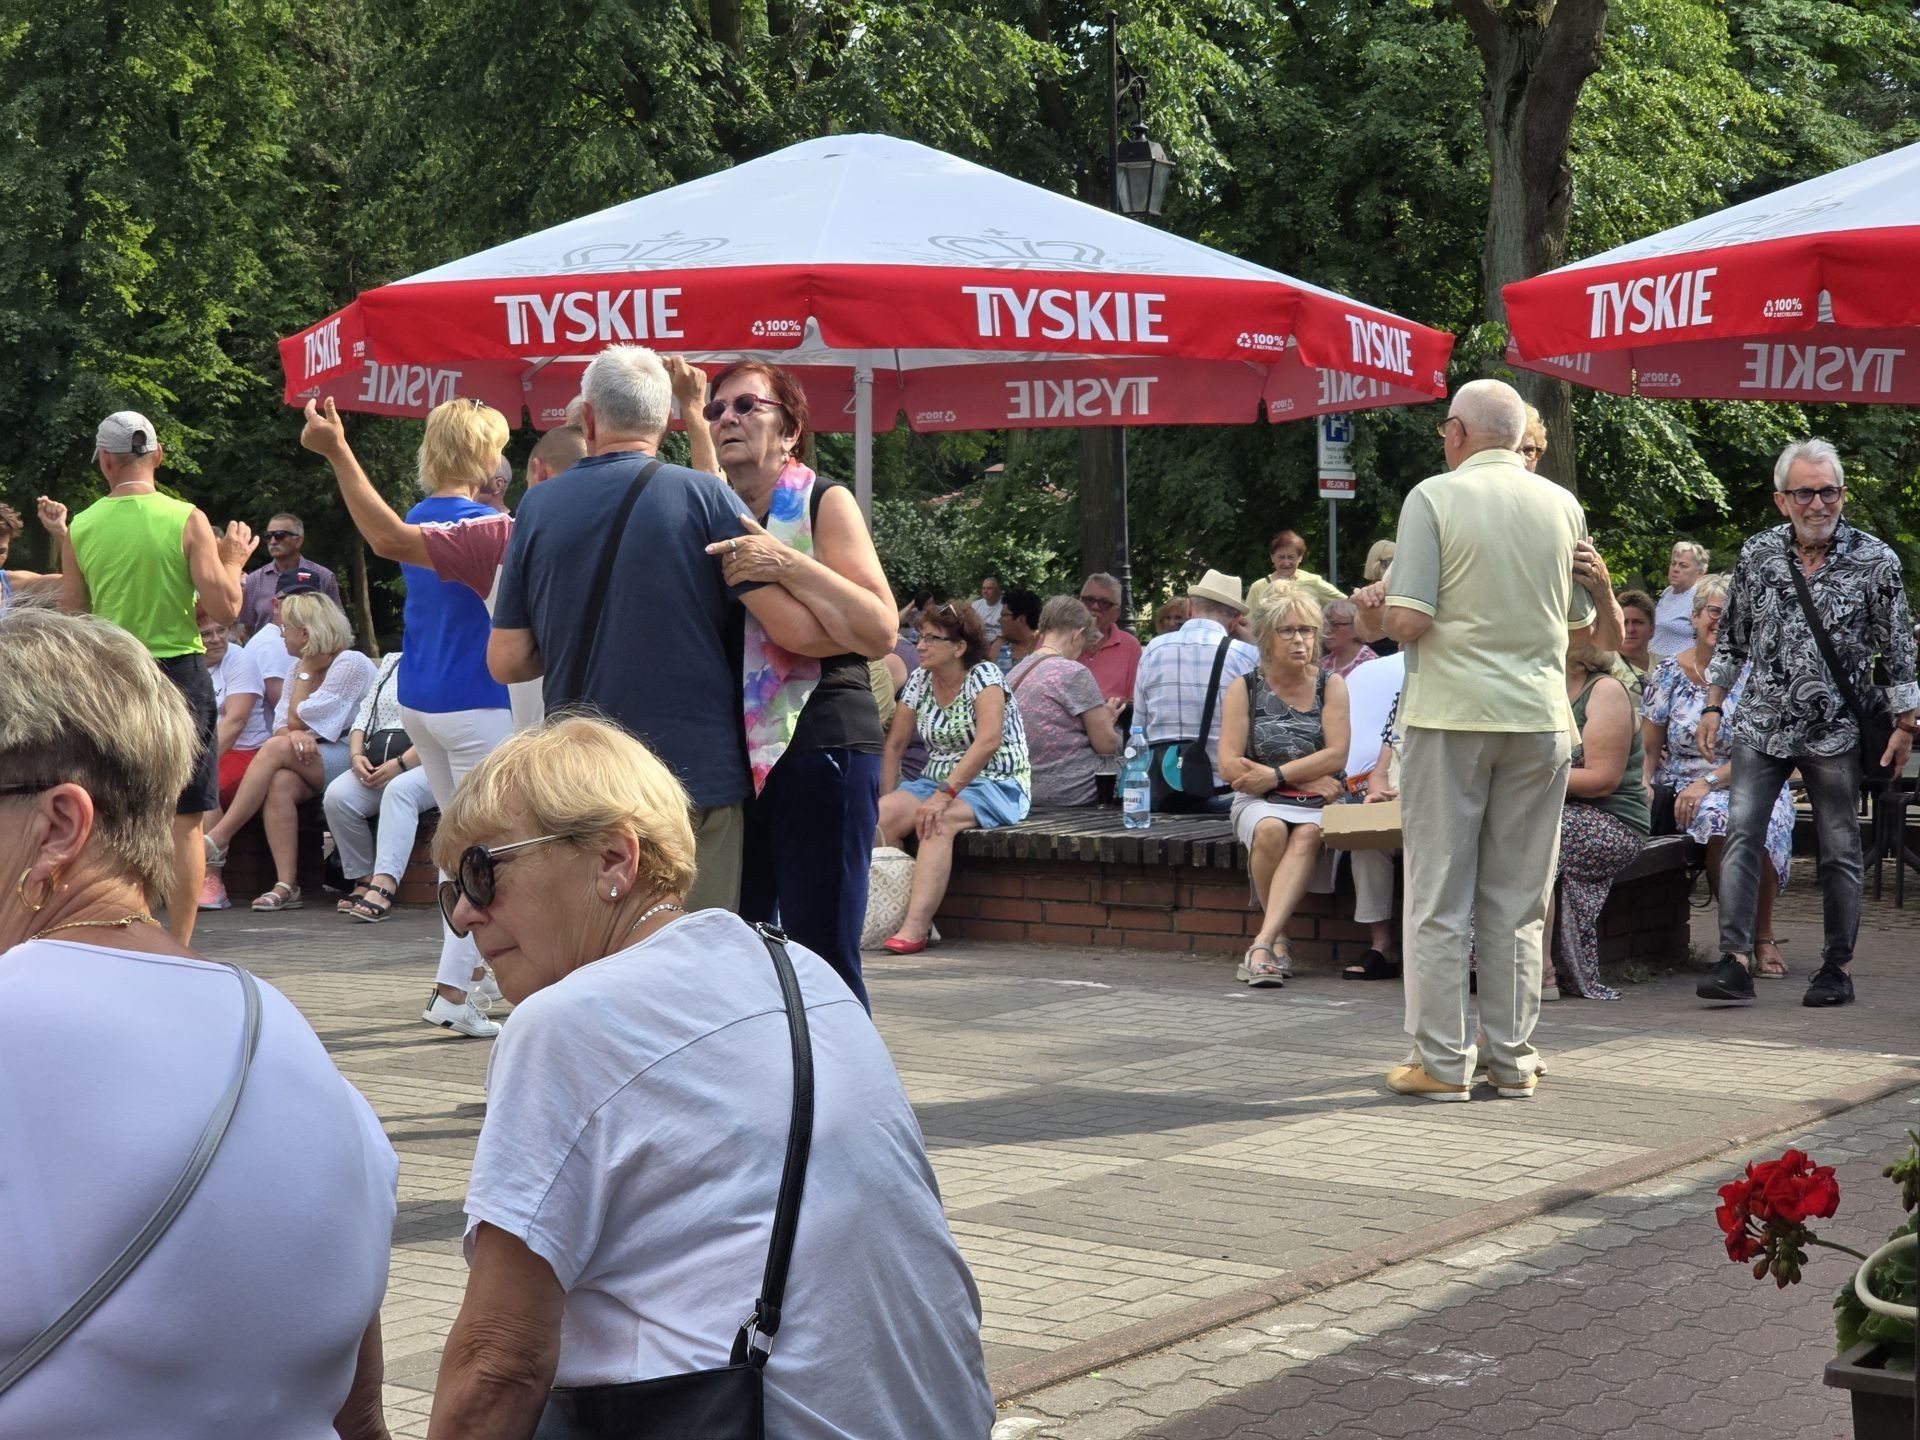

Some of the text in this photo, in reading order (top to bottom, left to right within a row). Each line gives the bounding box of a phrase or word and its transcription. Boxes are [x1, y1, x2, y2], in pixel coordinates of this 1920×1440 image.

[495, 287, 684, 345] TYSKIE
[766, 320, 801, 331] 100%
[962, 286, 1169, 343] TYSKIE
[1586, 268, 1718, 339] TYSKIE
[1774, 298, 1802, 311] 100%
[304, 317, 342, 380] TYSKIE
[1252, 333, 1284, 346] 100%
[1345, 314, 1414, 377] TYSKIE
[1326, 480, 1345, 489] REJON
